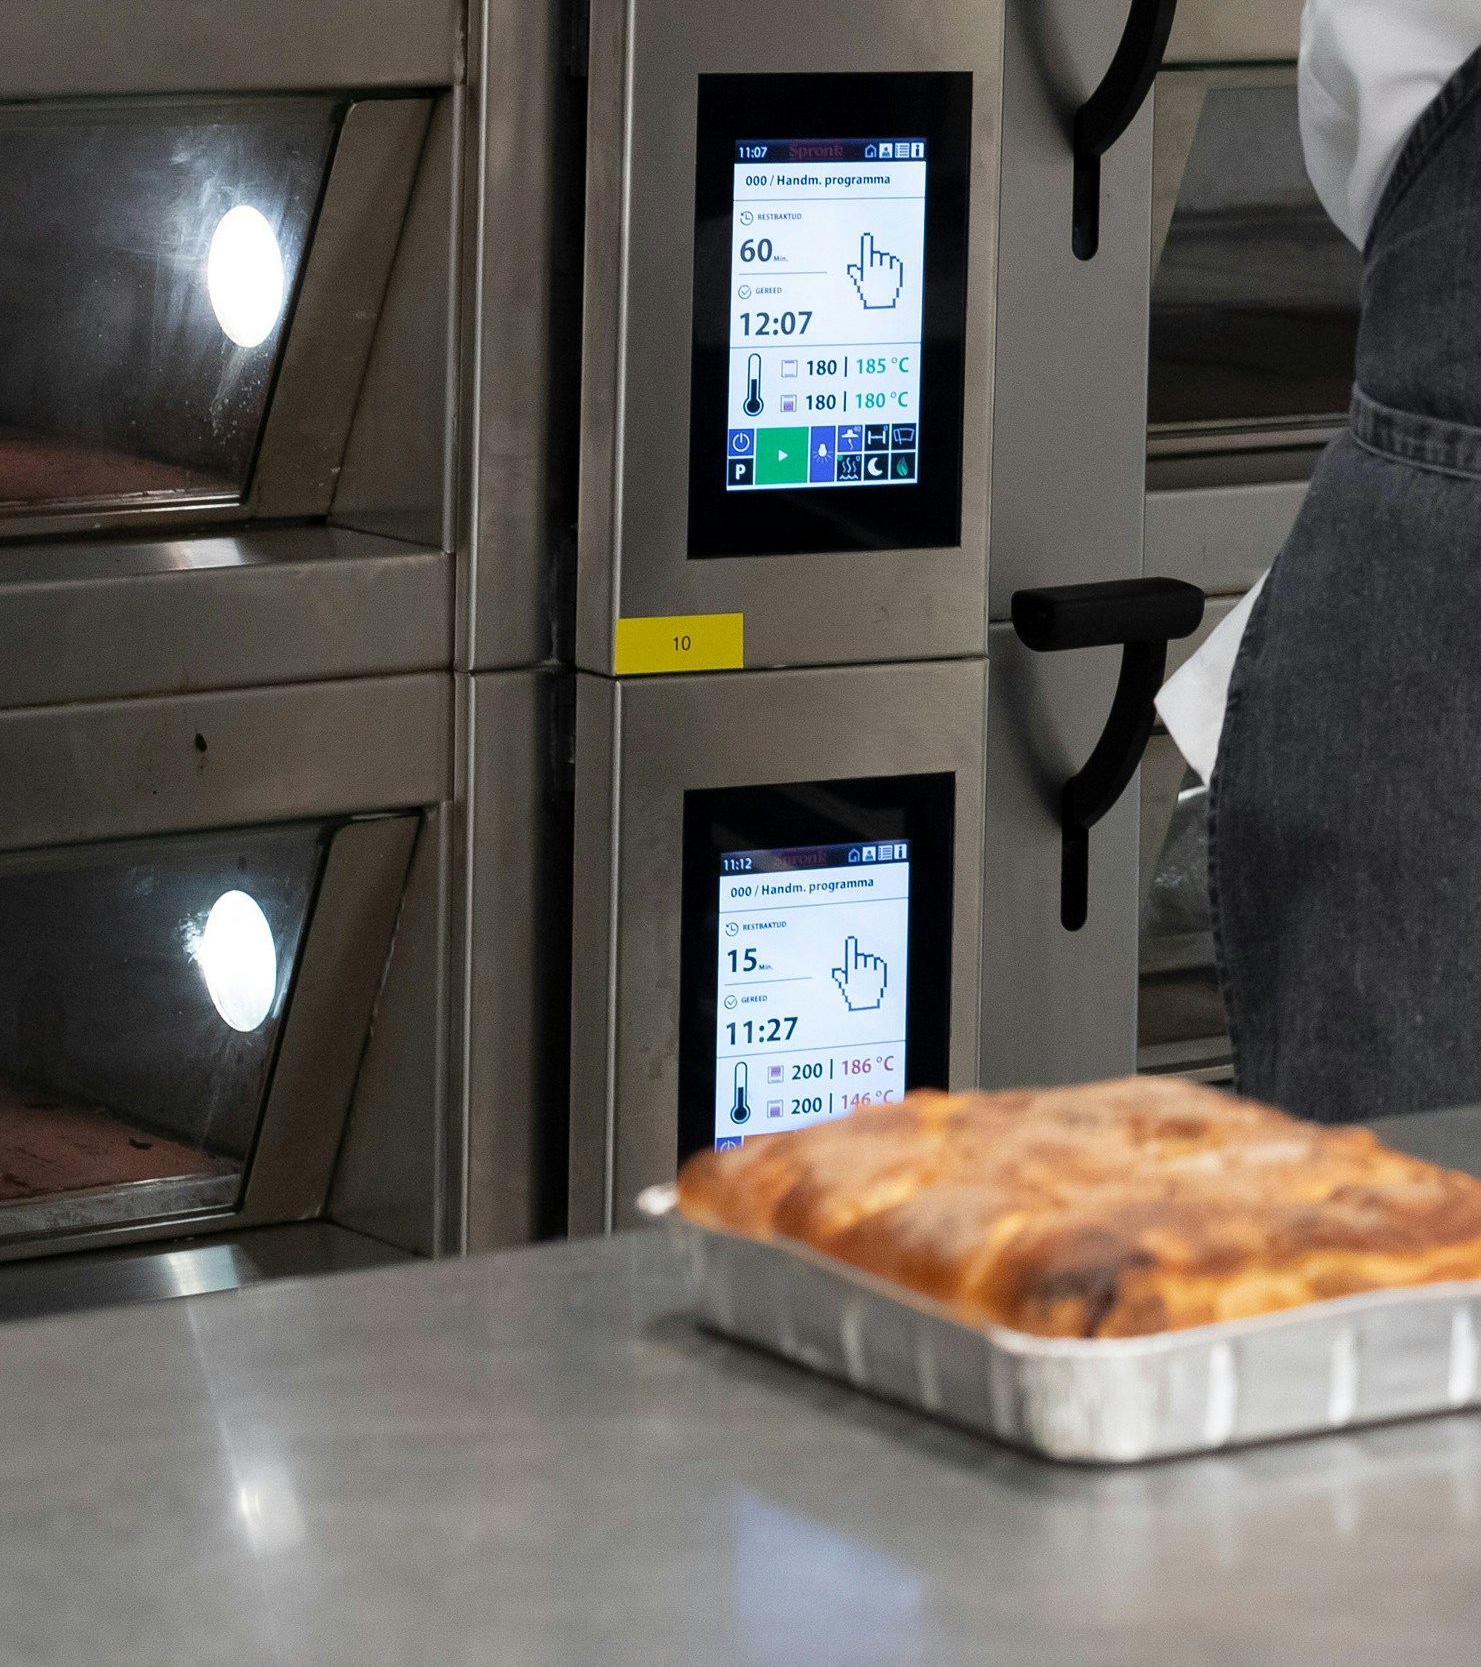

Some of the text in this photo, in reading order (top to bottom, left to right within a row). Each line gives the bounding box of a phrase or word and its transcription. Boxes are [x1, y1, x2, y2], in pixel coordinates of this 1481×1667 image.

[739, 146, 767, 158] 11:07
[746, 175, 767, 186] 000
[777, 174, 822, 186] Handm.
[825, 175, 891, 188] programma
[740, 238, 773, 263] 60
[740, 311, 813, 336] 12:07
[807, 359, 837, 376] 180
[857, 358, 886, 374] 185
[892, 357, 909, 373] °C
[806, 394, 836, 410] 180
[856, 393, 885, 409] 180
[890, 391, 908, 408] °C
[673, 636, 691, 651] 10
[724, 858, 752, 871] 11:12
[731, 886, 752, 898] 000
[761, 883, 806, 896] Handm.
[809, 879, 874, 894] programma
[727, 948, 758, 973] 15
[741, 995, 768, 1004] GEREED
[726, 1016, 798, 1045] 11:27
[792, 1063, 823, 1080] 200
[842, 1058, 872, 1075] 186
[876, 1055, 894, 1072] °C
[791, 1097, 822, 1114] 200
[875, 1089, 894, 1103] °C
